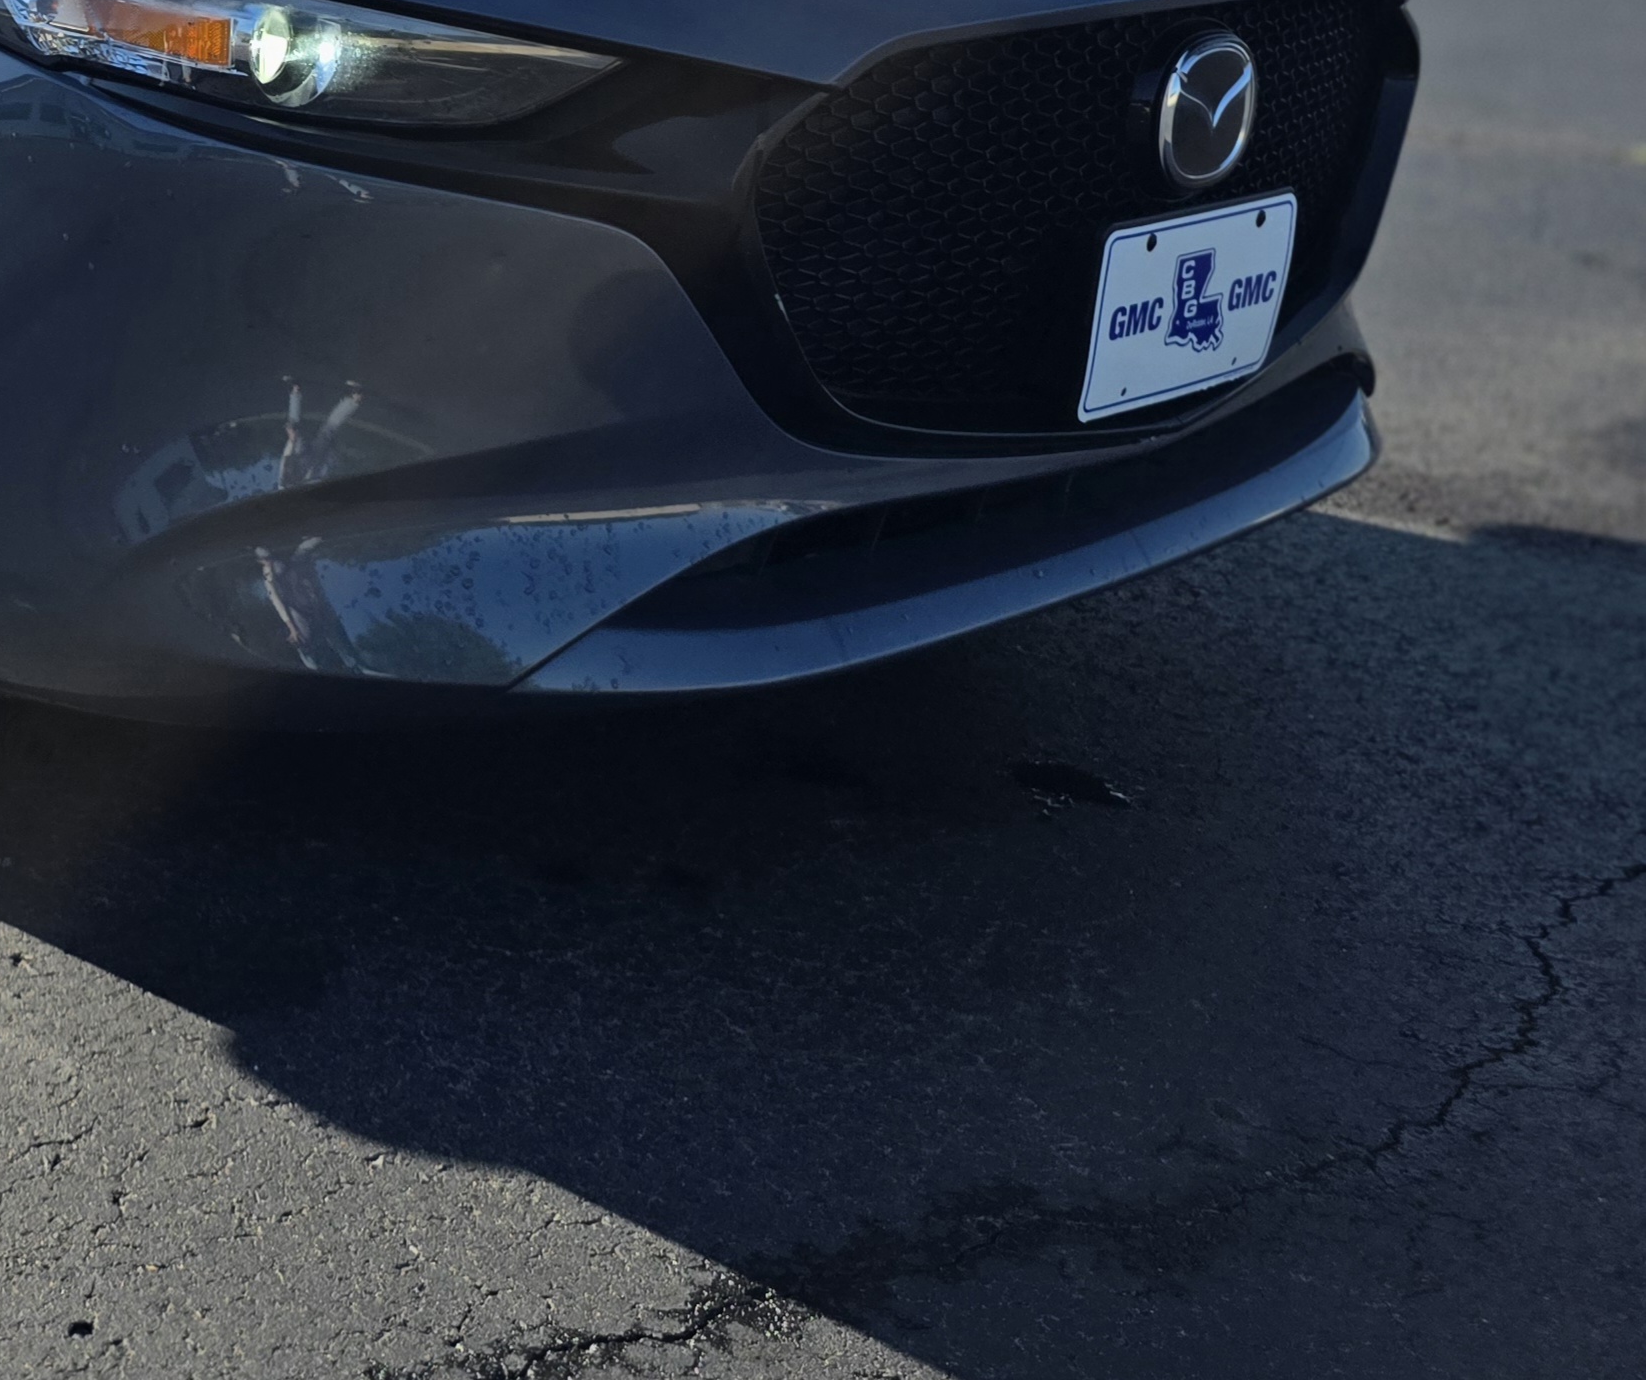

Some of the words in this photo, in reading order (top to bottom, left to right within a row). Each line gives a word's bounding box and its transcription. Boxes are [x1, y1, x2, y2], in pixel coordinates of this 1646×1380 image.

[1181, 260, 1197, 318] CBG
[1227, 270, 1277, 311] GMC
[1109, 297, 1164, 341] GMC
